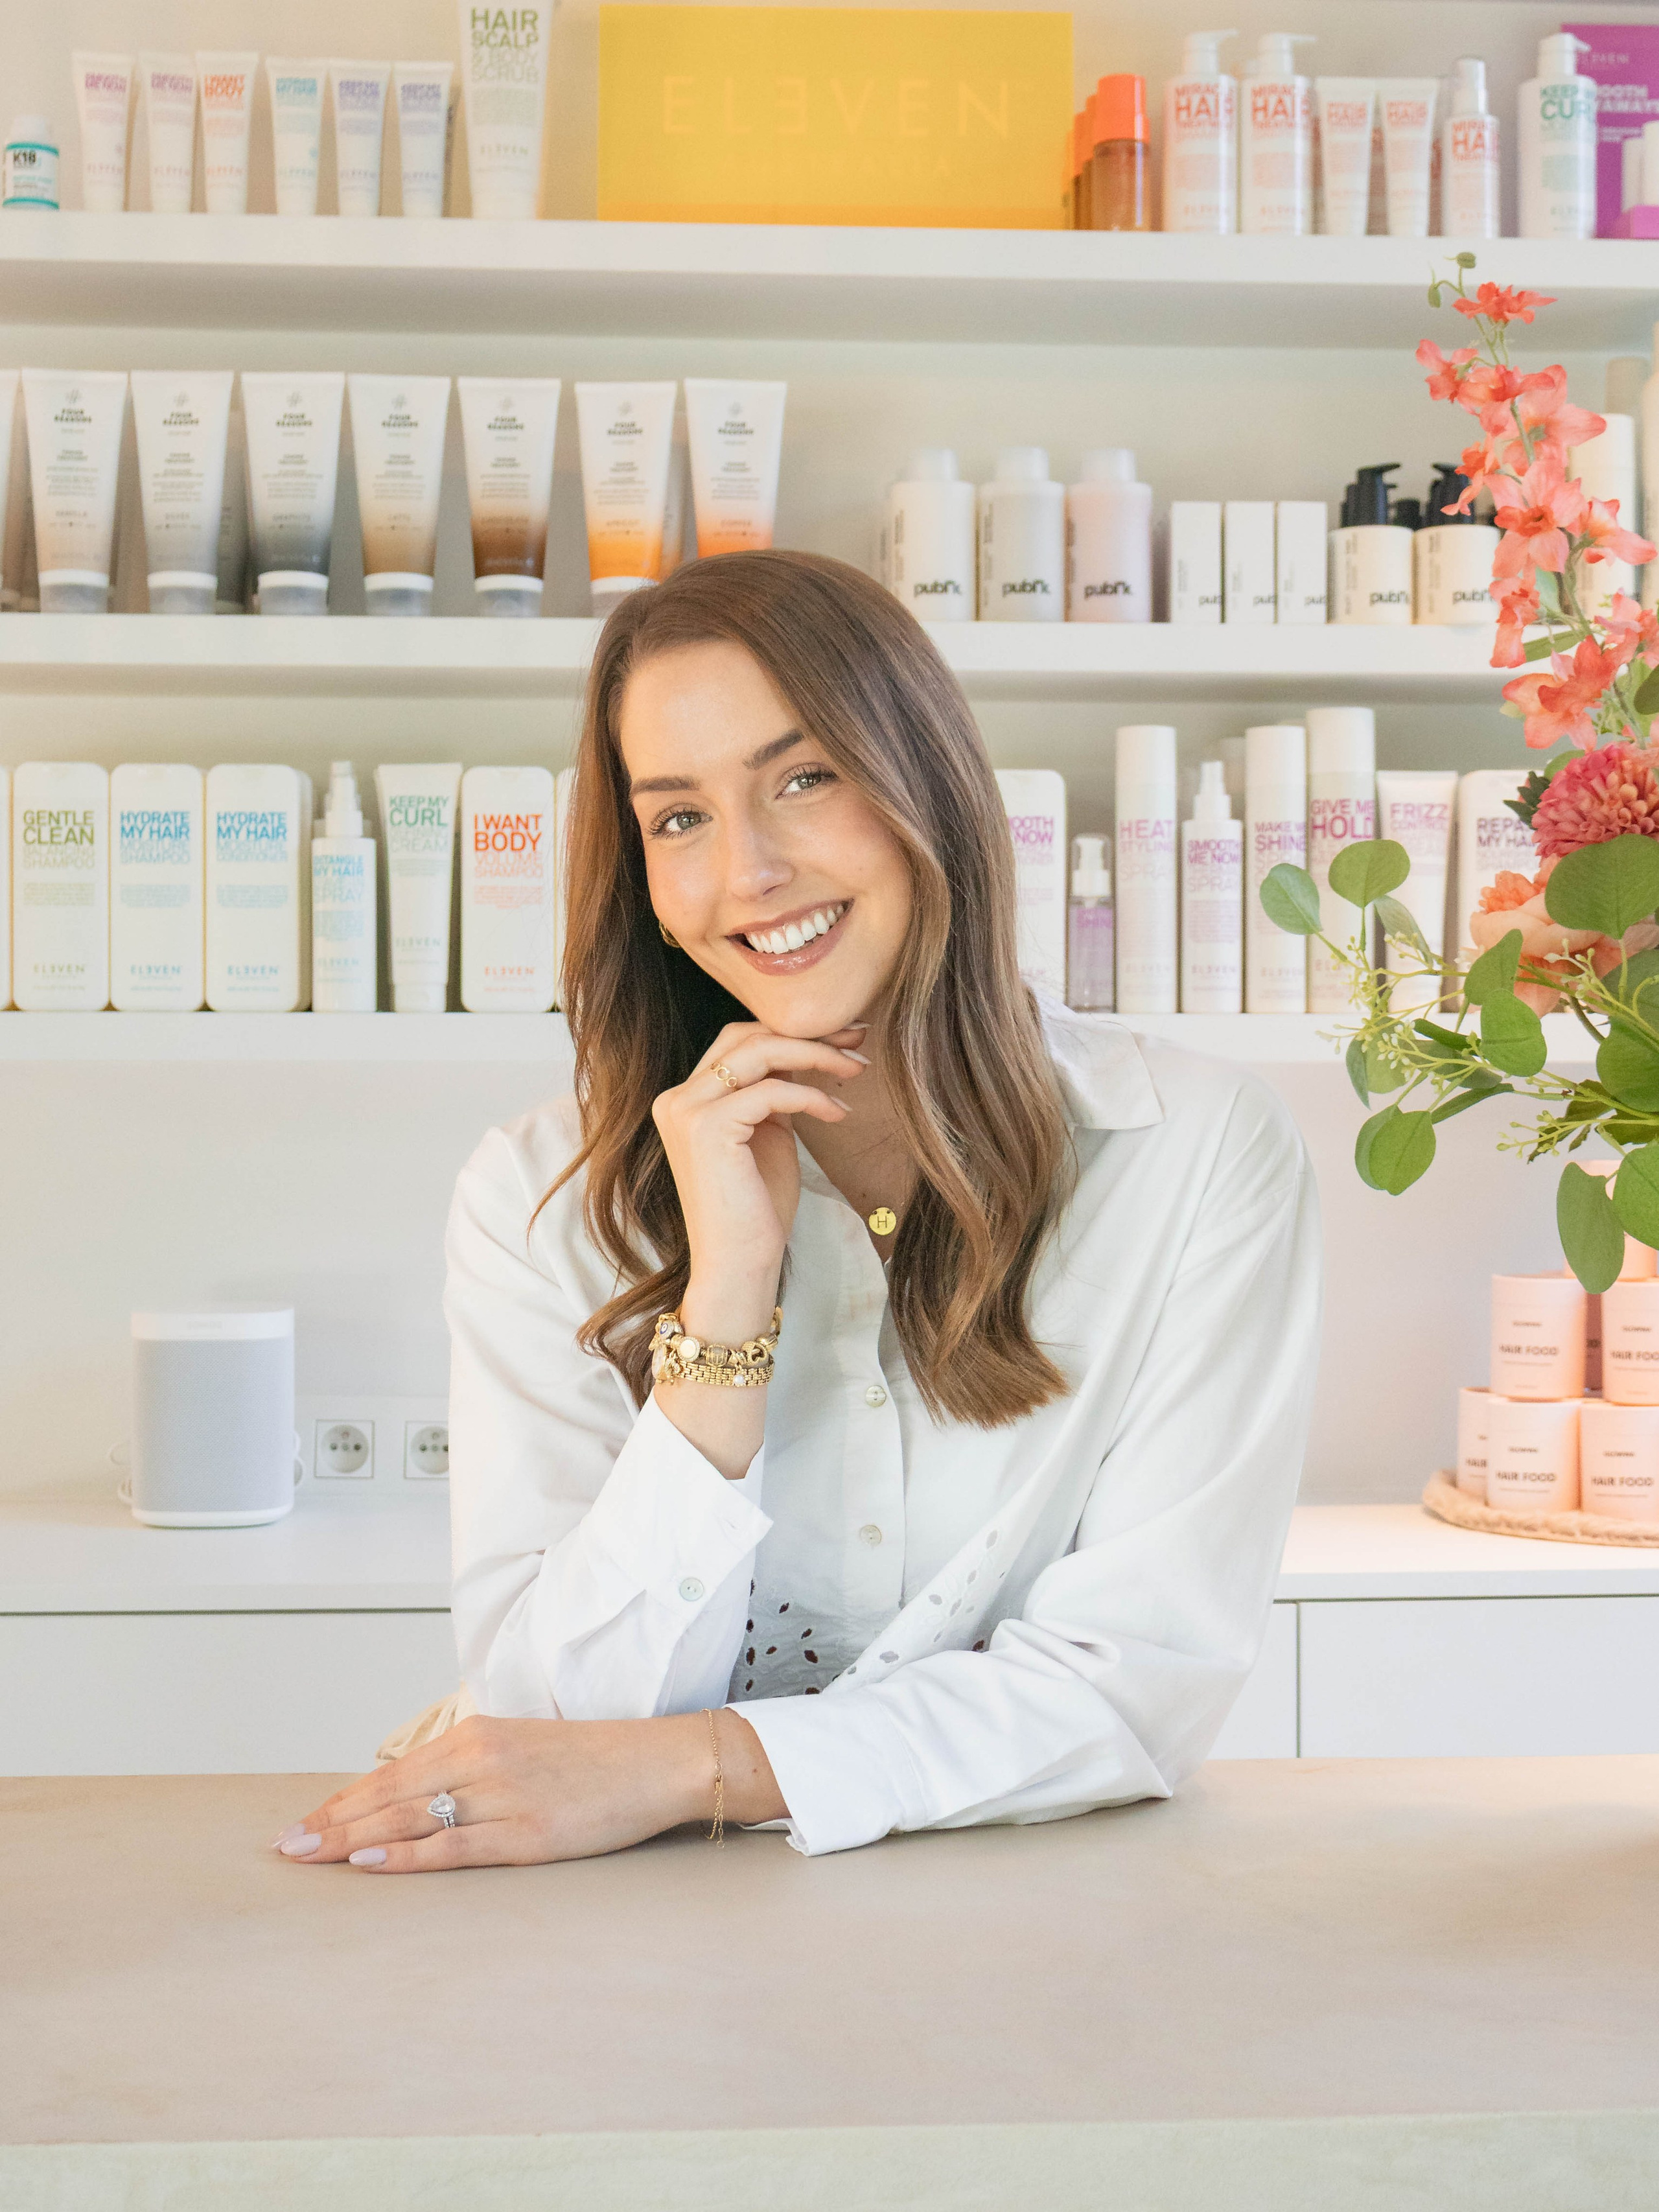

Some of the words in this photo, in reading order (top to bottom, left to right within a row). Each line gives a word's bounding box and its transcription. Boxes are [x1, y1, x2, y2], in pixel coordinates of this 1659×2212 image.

[471, 8, 539, 31] HAIR
[472, 32, 539, 49] SCALP
[472, 65, 539, 83] SCRUB
[13, 150, 36, 165] K18
[389, 796, 425, 807] KEEP
[428, 796, 448, 807] MY
[1310, 798, 1351, 815] GIVE
[23, 810, 95, 825] GENTLE
[121, 811, 190, 824] HYDRATE
[216, 811, 287, 824] HYDRATE
[389, 808, 448, 826] CURL
[1390, 803, 1448, 819] FRIZZ
[474, 815, 478, 830] I
[481, 815, 543, 830] WANT
[1120, 819, 1174, 839] HEAT
[1255, 821, 1291, 832] MAKE
[23, 826, 95, 845] CLEAN
[121, 824, 145, 840] MY
[150, 824, 190, 840] HAIR
[217, 825, 243, 841] MY
[246, 825, 287, 841] HAIR
[474, 832, 542, 852] BODY
[1478, 834, 1500, 847] MY
[23, 856, 95, 869] SHAMPOO
[121, 852, 190, 865] SHAMPOO
[475, 852, 542, 865] VOLUME
[332, 865, 364, 876] HAIR
[475, 865, 543, 878] SHAMPOO
[877, 1216, 888, 1228] H
[1500, 1344, 1522, 1354] HAIR
[1526, 1345, 1559, 1355] FOOD
[1611, 1350, 1633, 1360] HAIR
[1496, 1471, 1519, 1481] HAIR
[1523, 1472, 1557, 1482] FOOD
[1591, 1476, 1615, 1486] HAIR
[1619, 1477, 1654, 1487] FOOD
